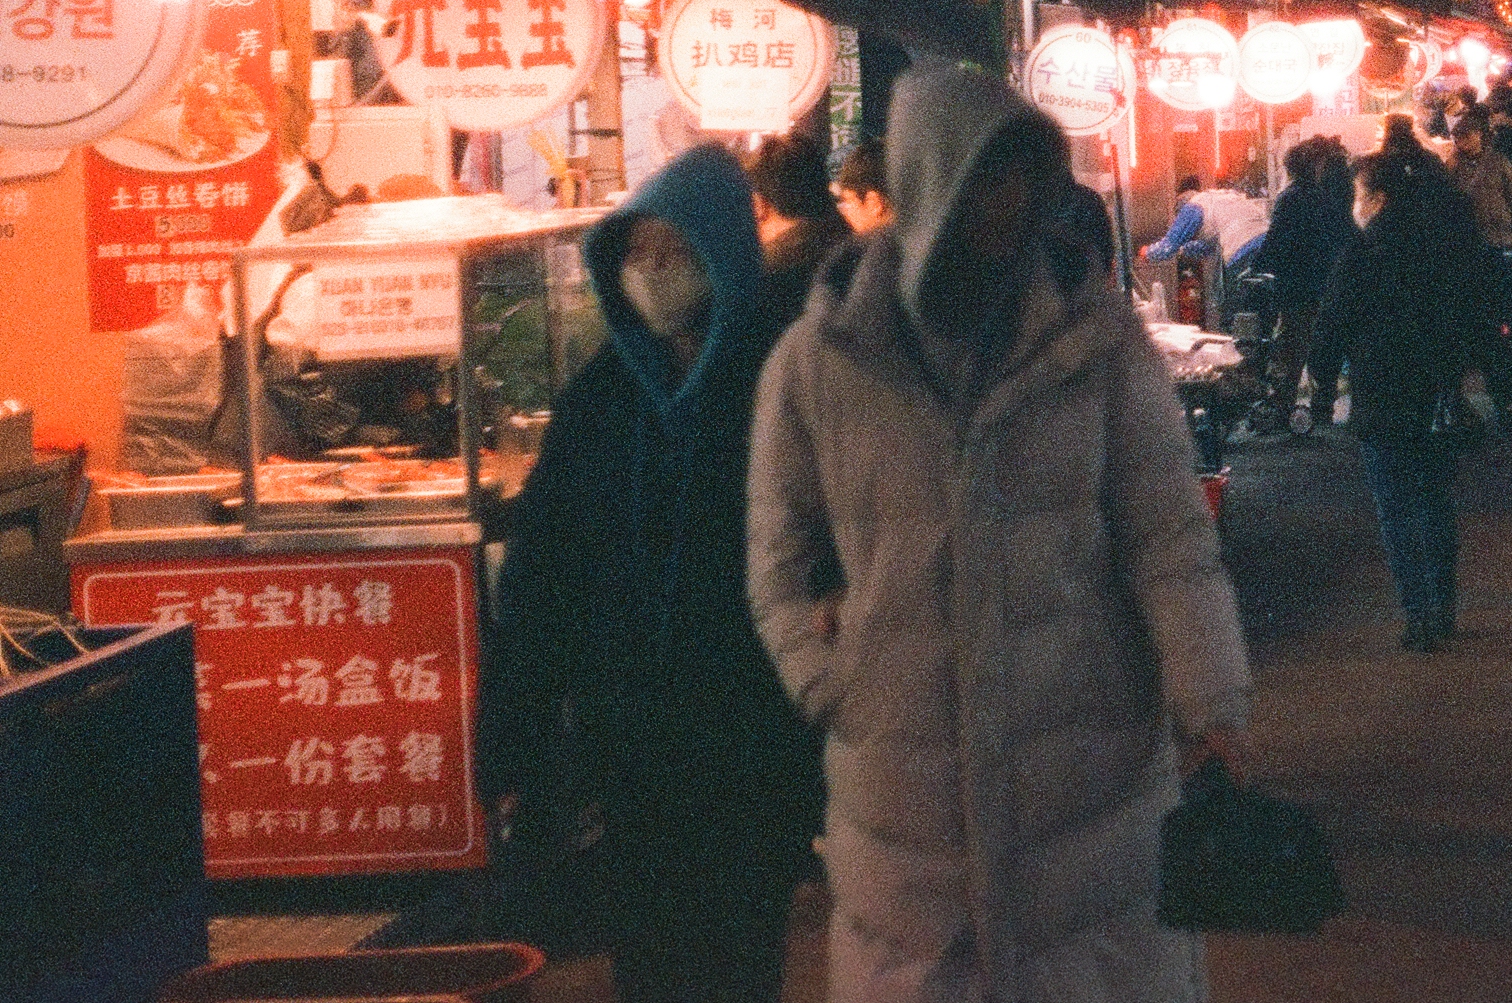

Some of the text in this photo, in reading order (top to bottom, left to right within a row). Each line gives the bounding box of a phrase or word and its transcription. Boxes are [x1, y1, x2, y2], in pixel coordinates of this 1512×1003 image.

[690, 40, 796, 69] 扒鸡店
[1036, 57, 1118, 94] 수산물
